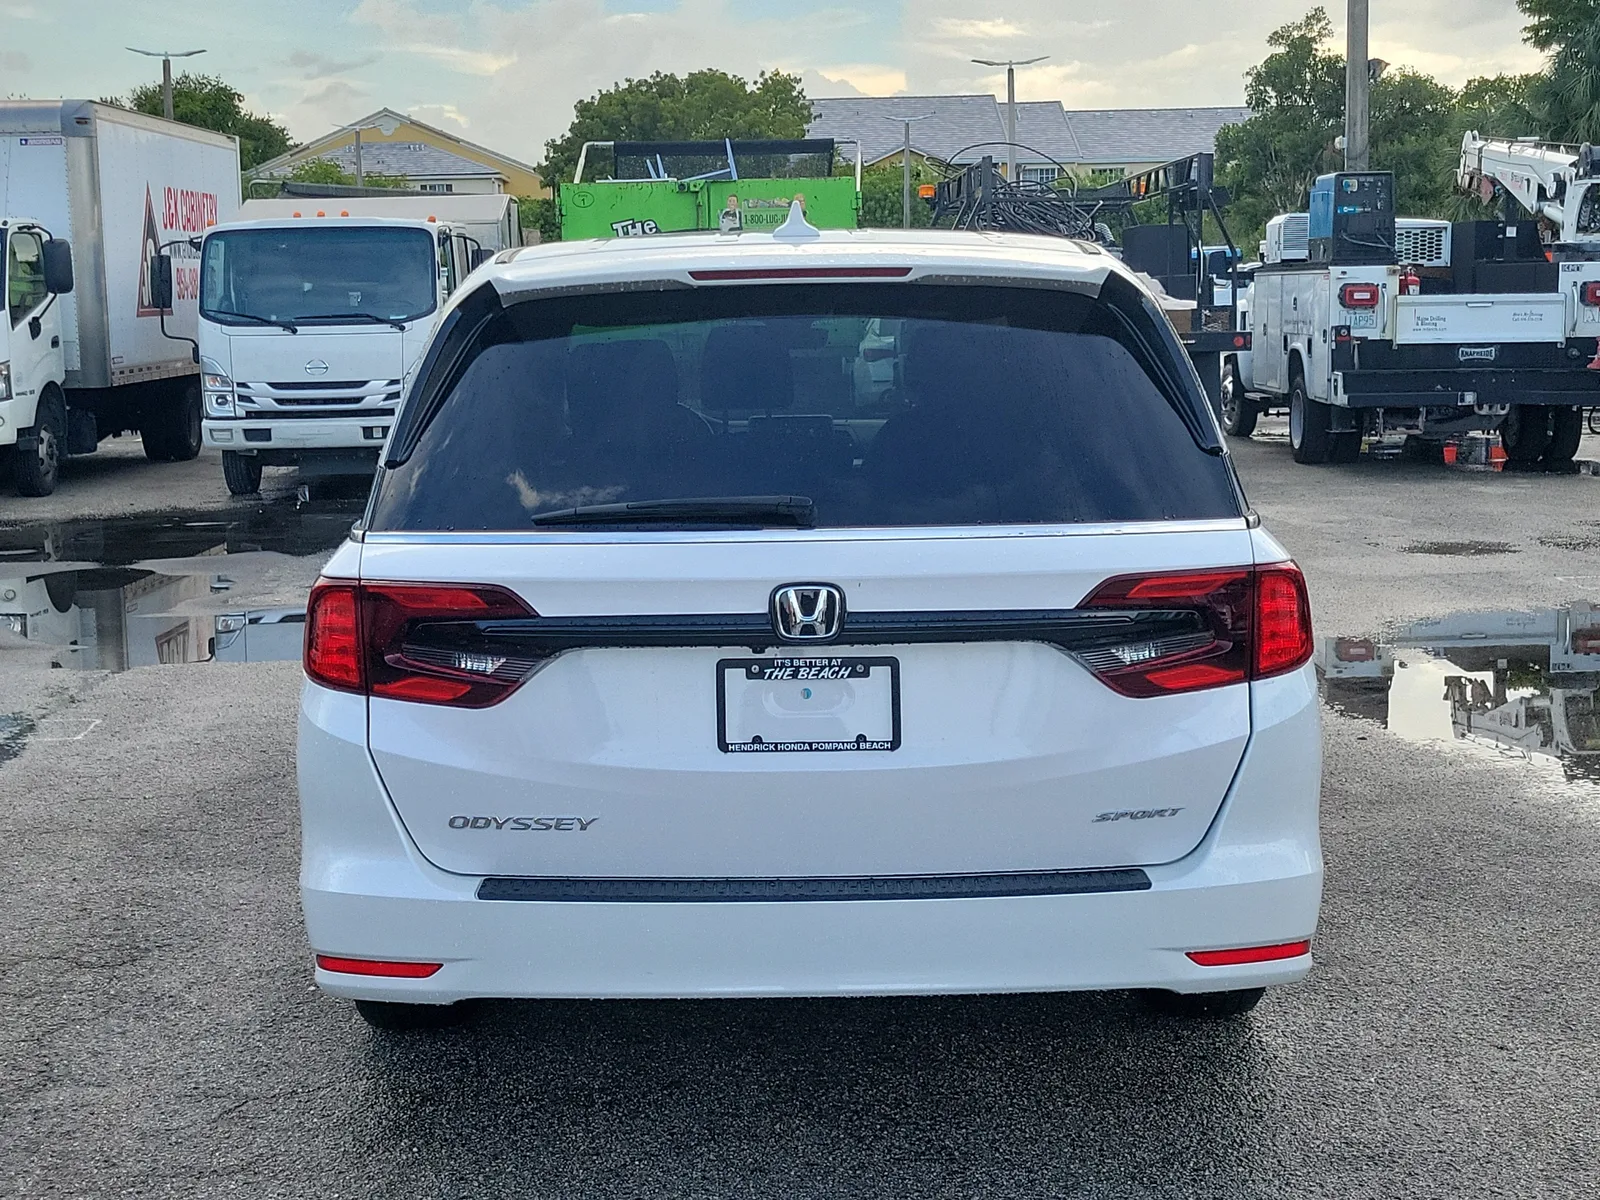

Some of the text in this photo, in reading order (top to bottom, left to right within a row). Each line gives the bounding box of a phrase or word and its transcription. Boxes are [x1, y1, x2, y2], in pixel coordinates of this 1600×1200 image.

[163, 186, 181, 231] J&K
[774, 658, 843, 667] IT'S BETTER AT
[763, 666, 852, 680] THE BEACH
[728, 741, 891, 752] HENDRICK HONDA POMPANO BEACH
[1091, 807, 1186, 823] SPORT
[448, 815, 600, 831] ODYSSEY
